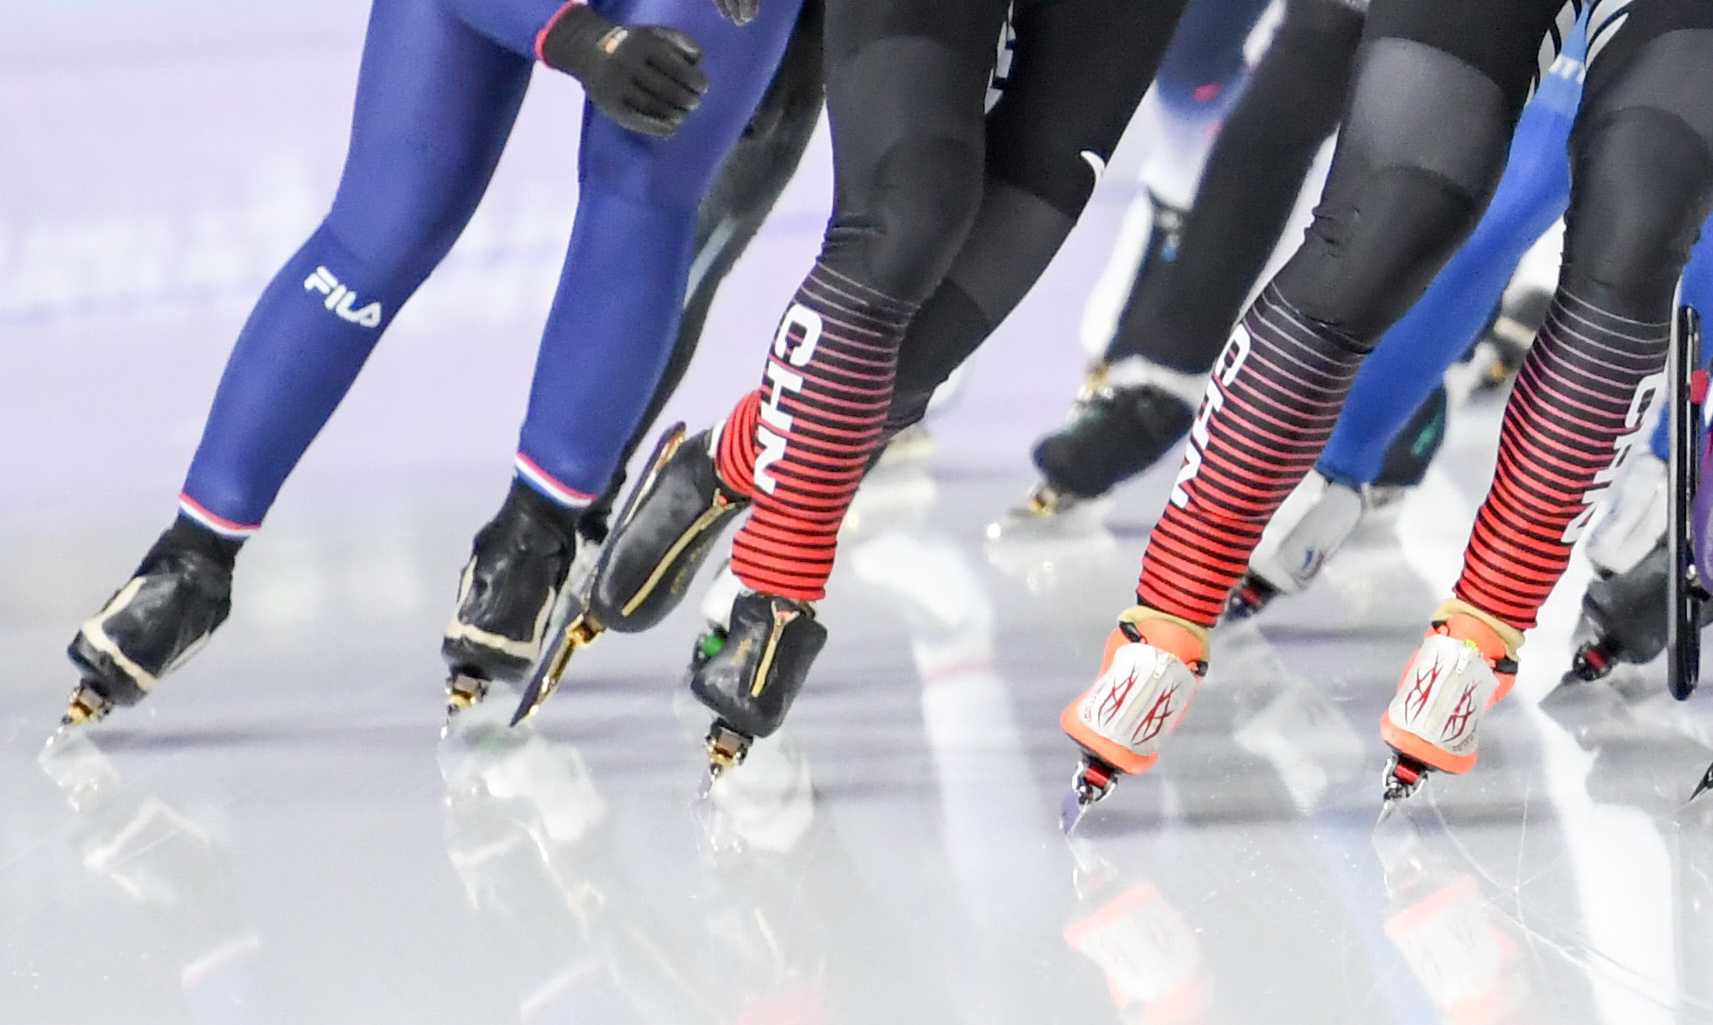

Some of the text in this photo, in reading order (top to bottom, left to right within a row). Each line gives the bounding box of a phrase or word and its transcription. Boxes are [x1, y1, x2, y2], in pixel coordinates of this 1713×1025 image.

[303, 265, 382, 329] FILA
[753, 303, 823, 495] CHN
[1170, 323, 1251, 509] CHN
